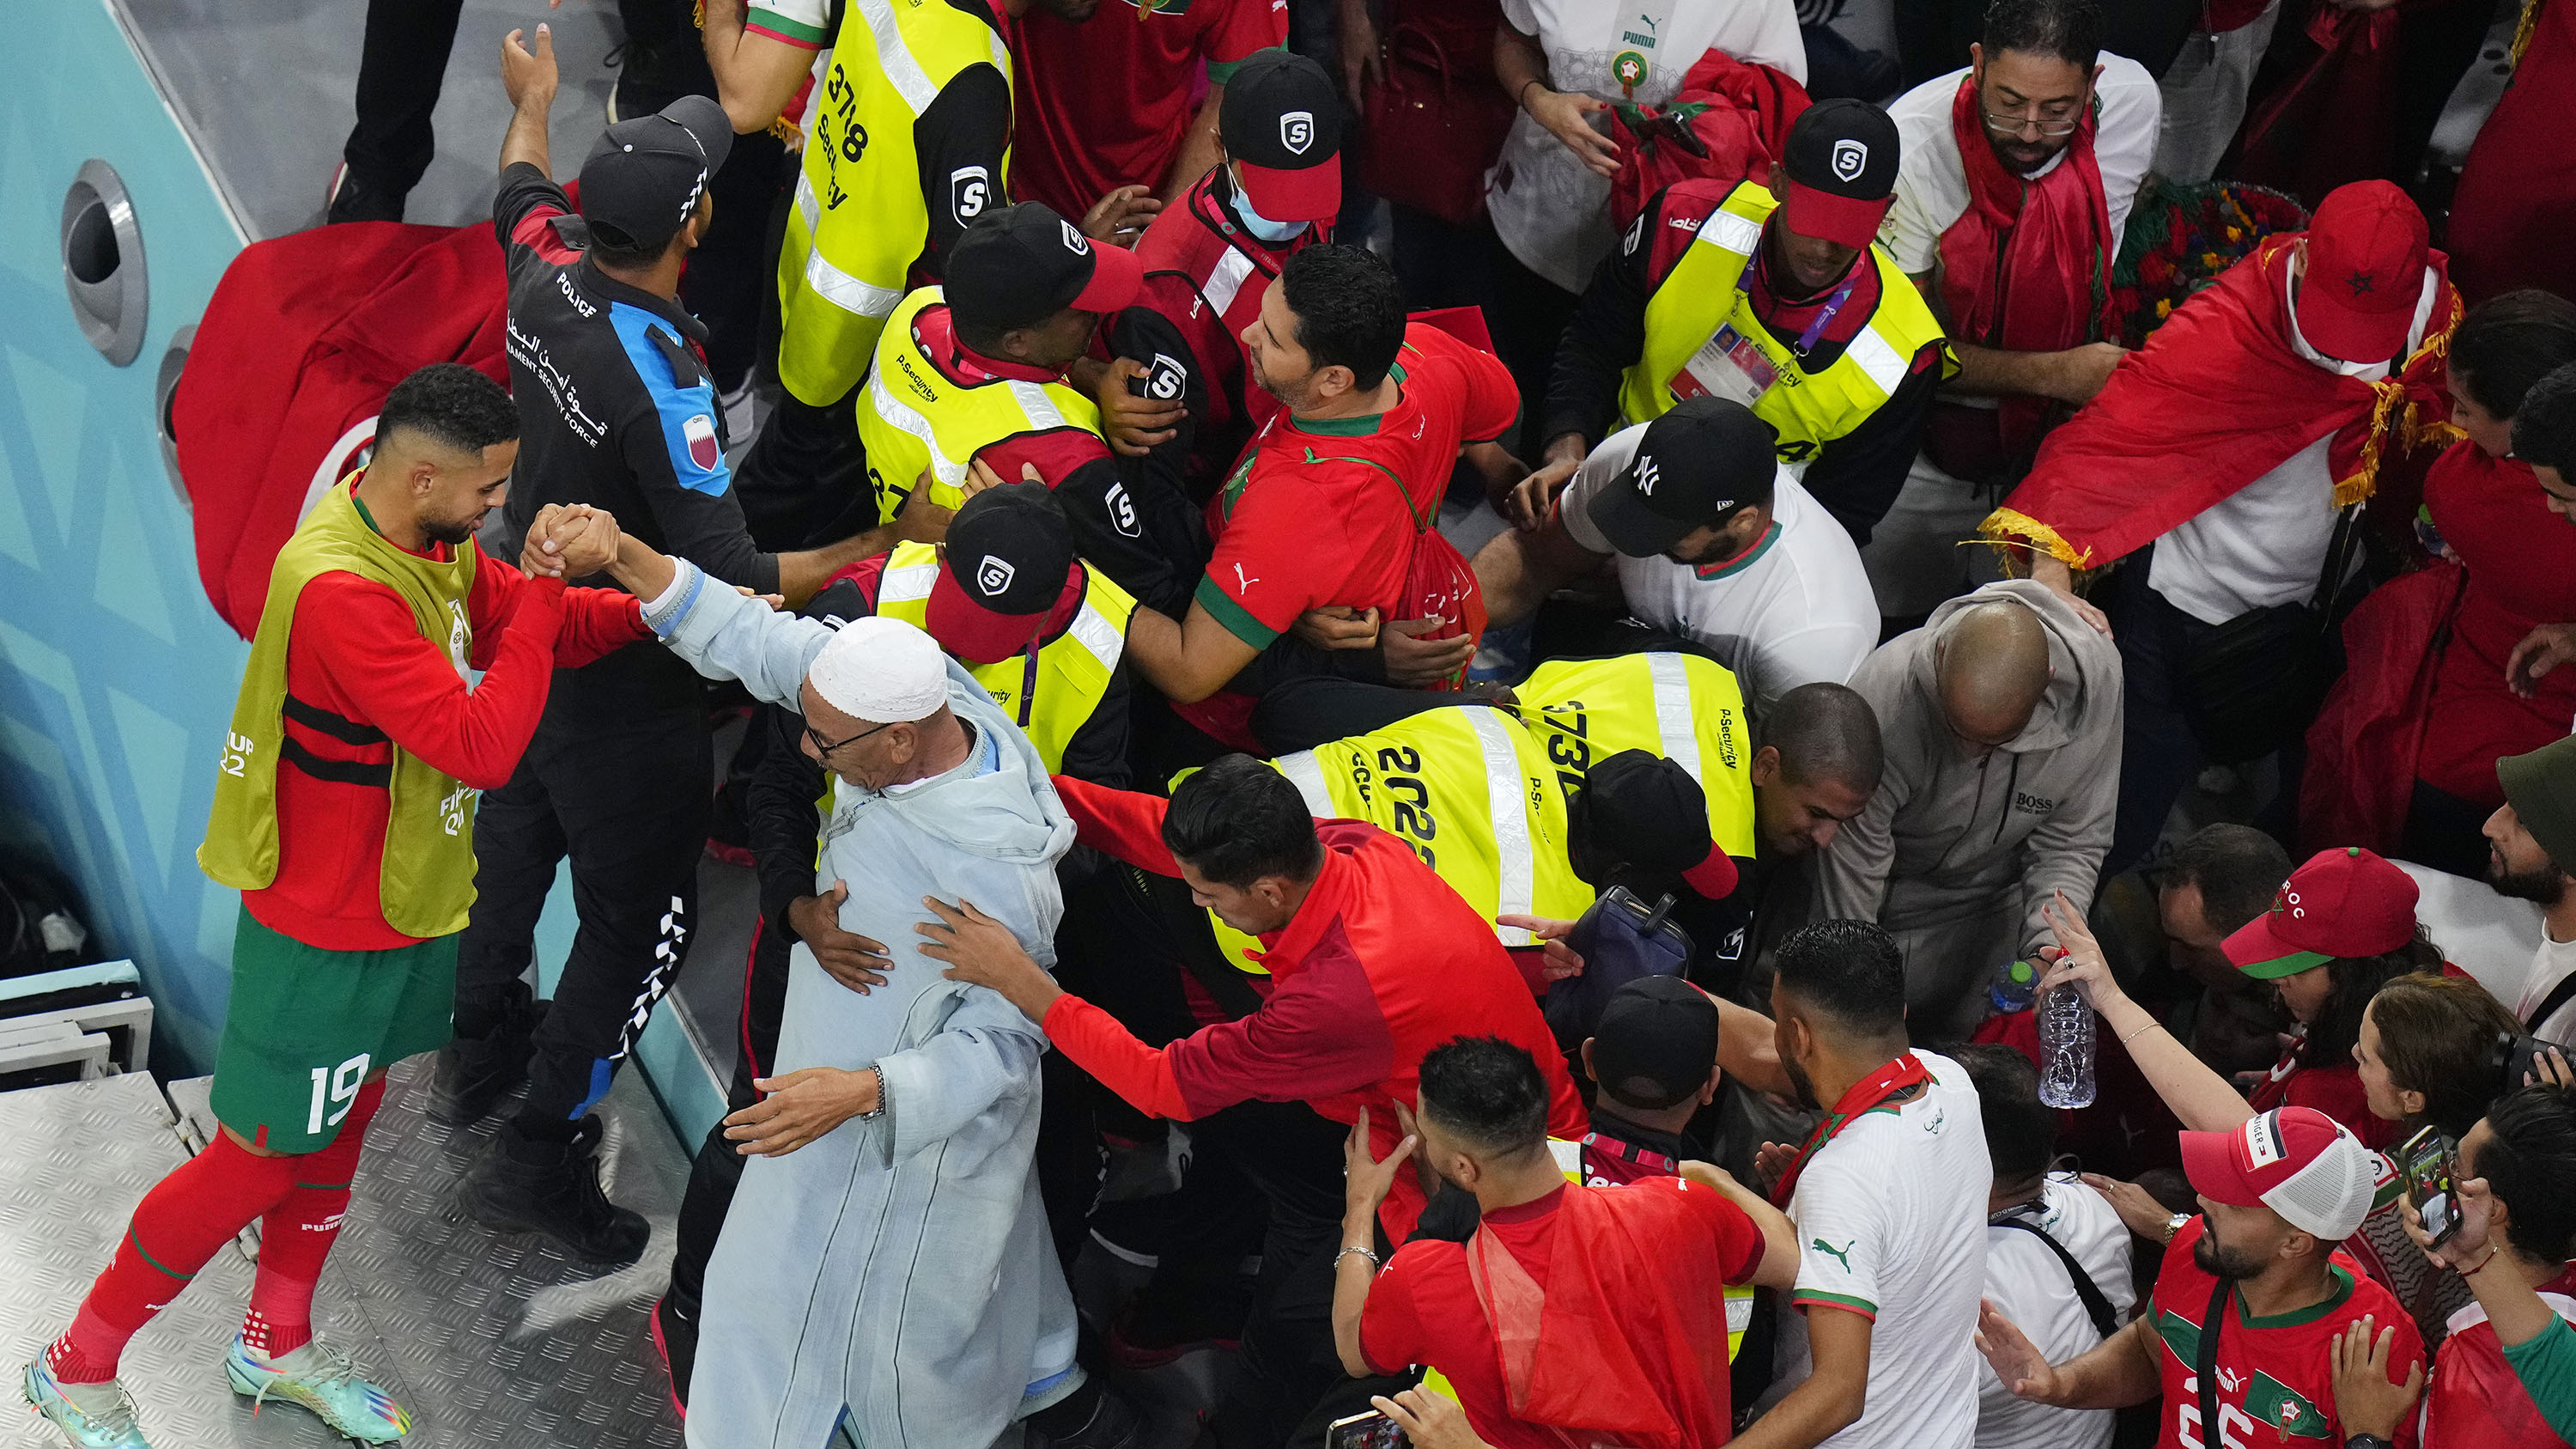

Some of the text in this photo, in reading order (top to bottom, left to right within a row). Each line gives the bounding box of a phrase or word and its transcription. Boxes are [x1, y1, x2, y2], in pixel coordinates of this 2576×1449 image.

[1622, 30, 1656, 49] PUMA
[556, 271, 598, 319] POLICE
[538, 368, 566, 415] SECURITY
[563, 411, 598, 449] FORCE
[227, 727, 254, 756] UP
[2016, 792, 2053, 810] BOSS
[2281, 879, 2306, 919] ROC
[307, 1052, 371, 1135] 19
